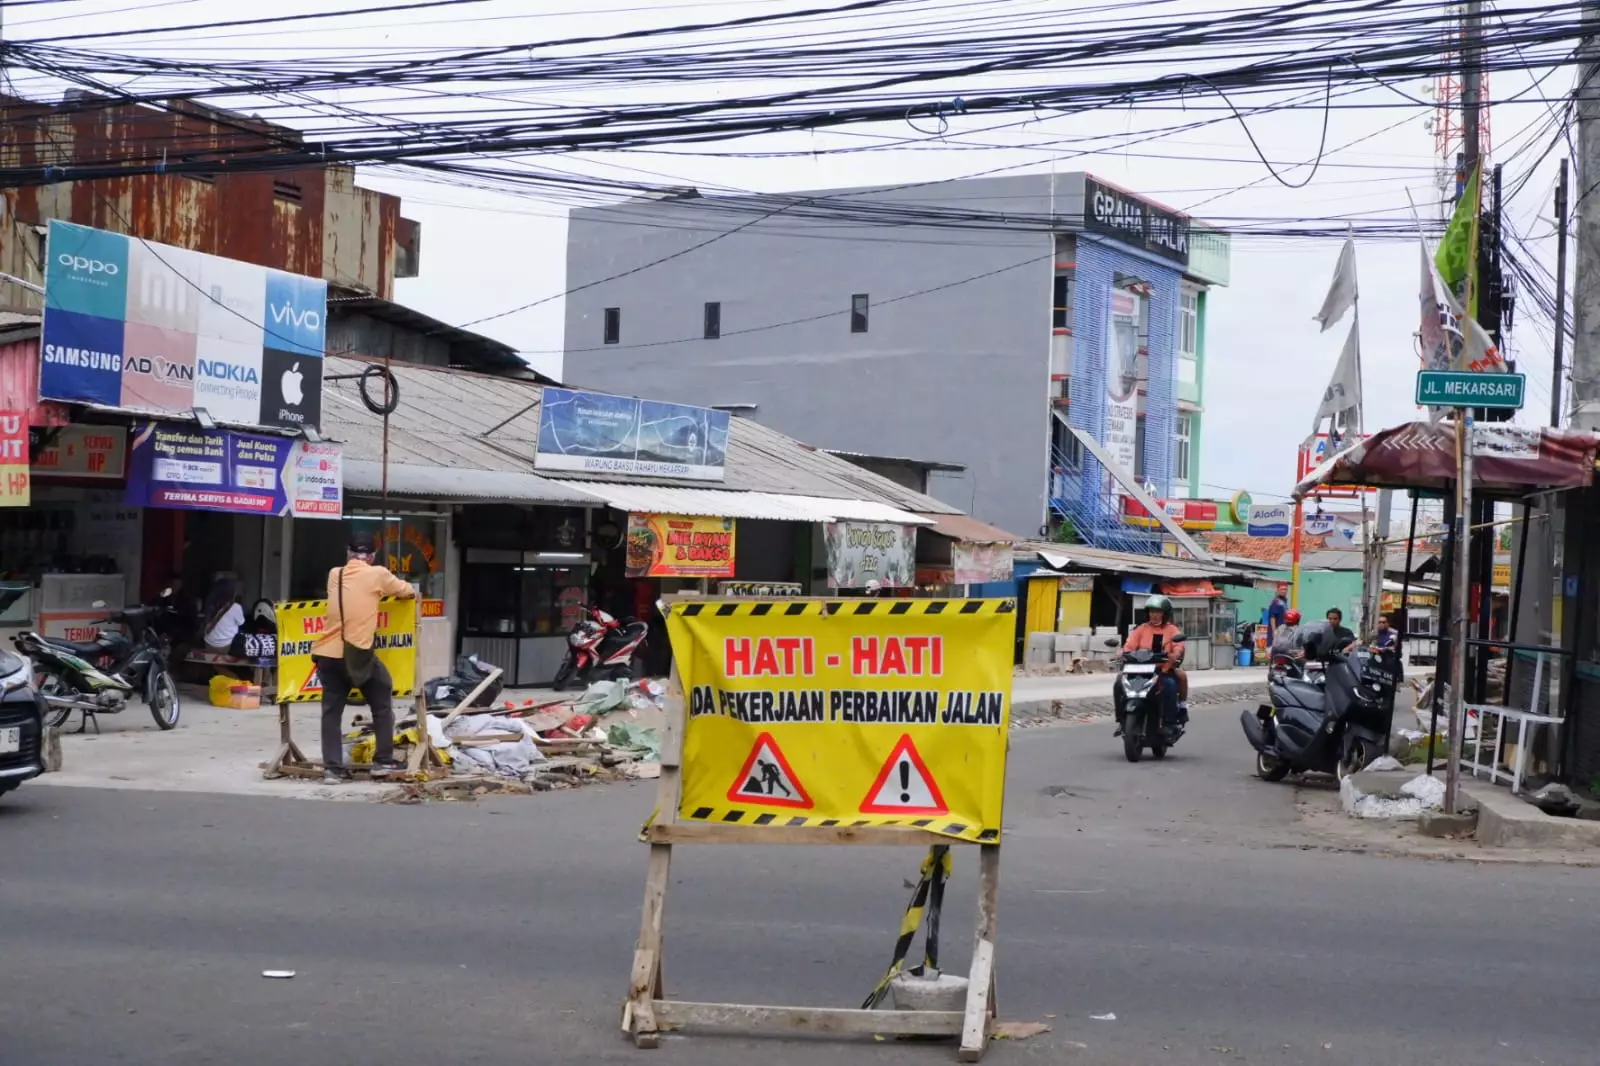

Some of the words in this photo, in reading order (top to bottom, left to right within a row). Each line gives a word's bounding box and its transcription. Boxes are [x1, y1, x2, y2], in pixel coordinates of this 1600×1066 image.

[1093, 190, 1143, 237] GRAHA
[58, 253, 119, 275] oppo
[270, 301, 320, 331] vivo
[44, 344, 121, 372] SAMSUNG
[198, 359, 259, 384] NOKIA
[196, 380, 234, 398] Connecting
[234, 386, 259, 401] People
[1423, 381, 1442, 395] JL.
[1444, 381, 1516, 398] MEKARSARI
[278, 408, 305, 423] iPhone
[83, 435, 114, 449] SERVIS
[87, 451, 106, 472] HP
[584, 458, 613, 470] WARUNG
[614, 460, 634, 471] BAKSO
[8, 472, 28, 496] HP
[164, 492, 197, 502] TERIMA
[198, 494, 225, 503] SERVIS
[296, 500, 318, 512] KARTU
[318, 501, 340, 514] KREDIT
[1253, 508, 1285, 519] Aladin
[666, 530, 692, 545] MIE
[693, 532, 732, 547] AYAM
[687, 546, 731, 561] BAKSO
[303, 616, 328, 634] HA
[281, 642, 297, 656] ADA
[388, 633, 413, 648] JALAN
[725, 637, 814, 676] HATI
[852, 636, 943, 675] HATI
[718, 689, 824, 722] PEKERJAAN
[830, 691, 938, 723] PERBAIKAN
[942, 692, 1003, 725] JALAN
